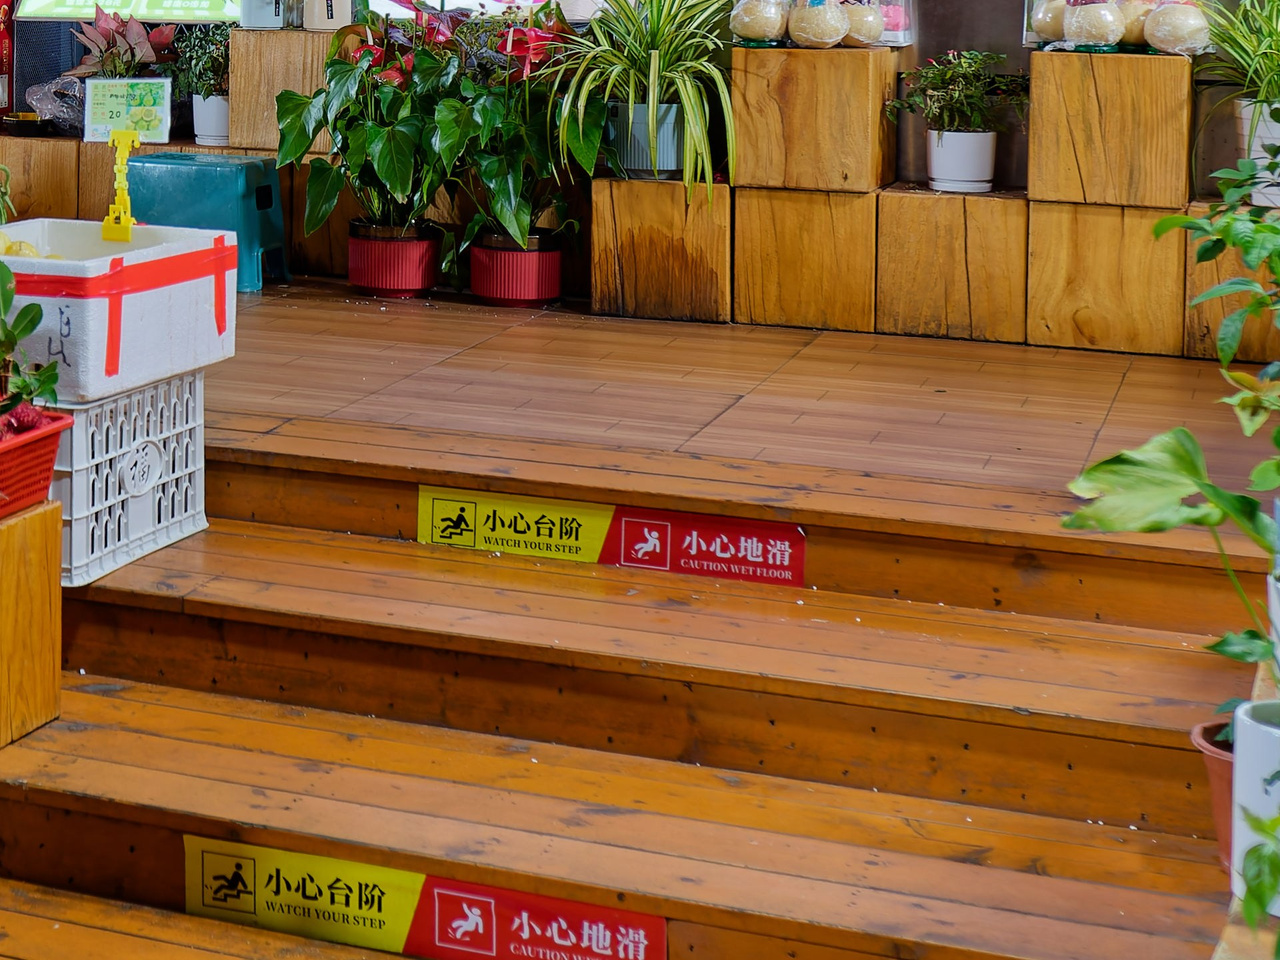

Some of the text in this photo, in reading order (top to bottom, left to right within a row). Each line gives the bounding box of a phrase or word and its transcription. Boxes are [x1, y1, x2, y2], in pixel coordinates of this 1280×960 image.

[108, 110, 121, 120] 20
[483, 509, 583, 542] 小心台阶
[483, 536, 582, 554] WATCH YOUR STEP
[682, 530, 792, 566] 小心地滑
[680, 559, 793, 580] CAUTION WET FLOOR
[264, 867, 387, 913] 小心台阶
[264, 901, 386, 930] WATCH YOUR STEP
[511, 910, 649, 960] 小心地滑
